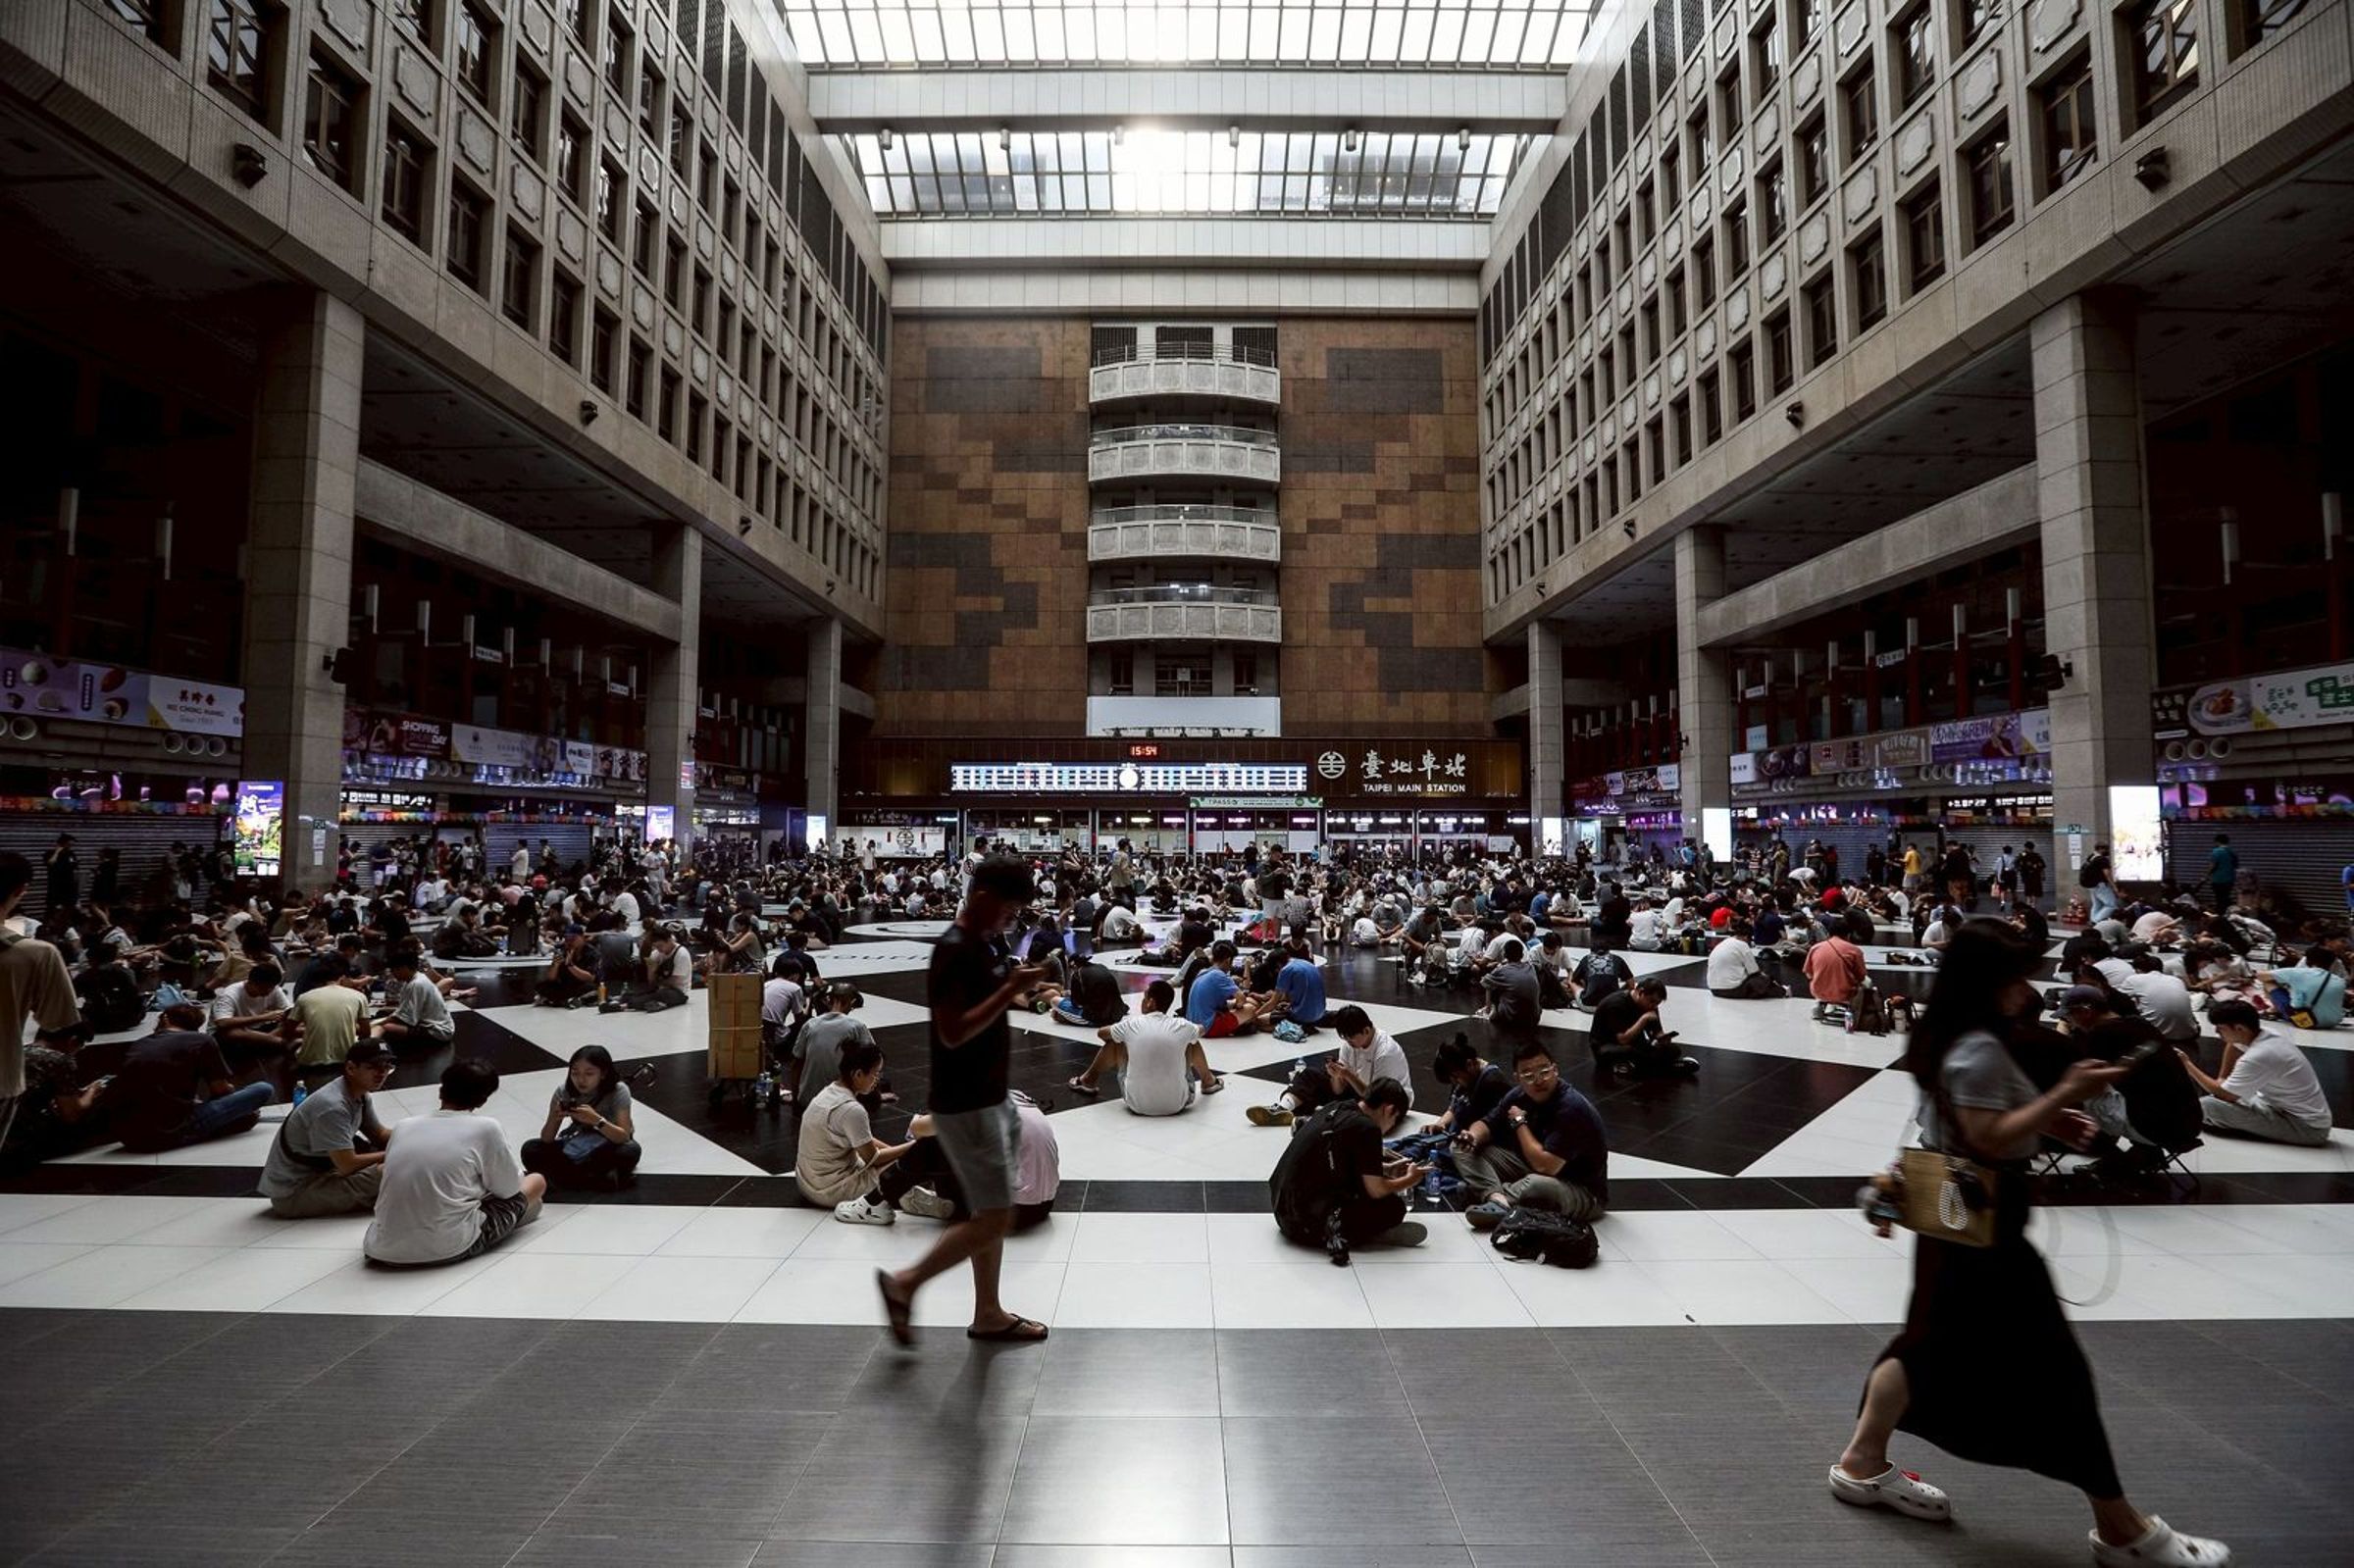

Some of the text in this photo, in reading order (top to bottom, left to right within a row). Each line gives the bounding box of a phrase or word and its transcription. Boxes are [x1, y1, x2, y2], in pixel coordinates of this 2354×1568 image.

[1130, 746, 1157, 756] 15:54
[1360, 749, 1466, 781] 臺北車站
[1363, 784, 1466, 792] TAIPEI MAIN STATION
